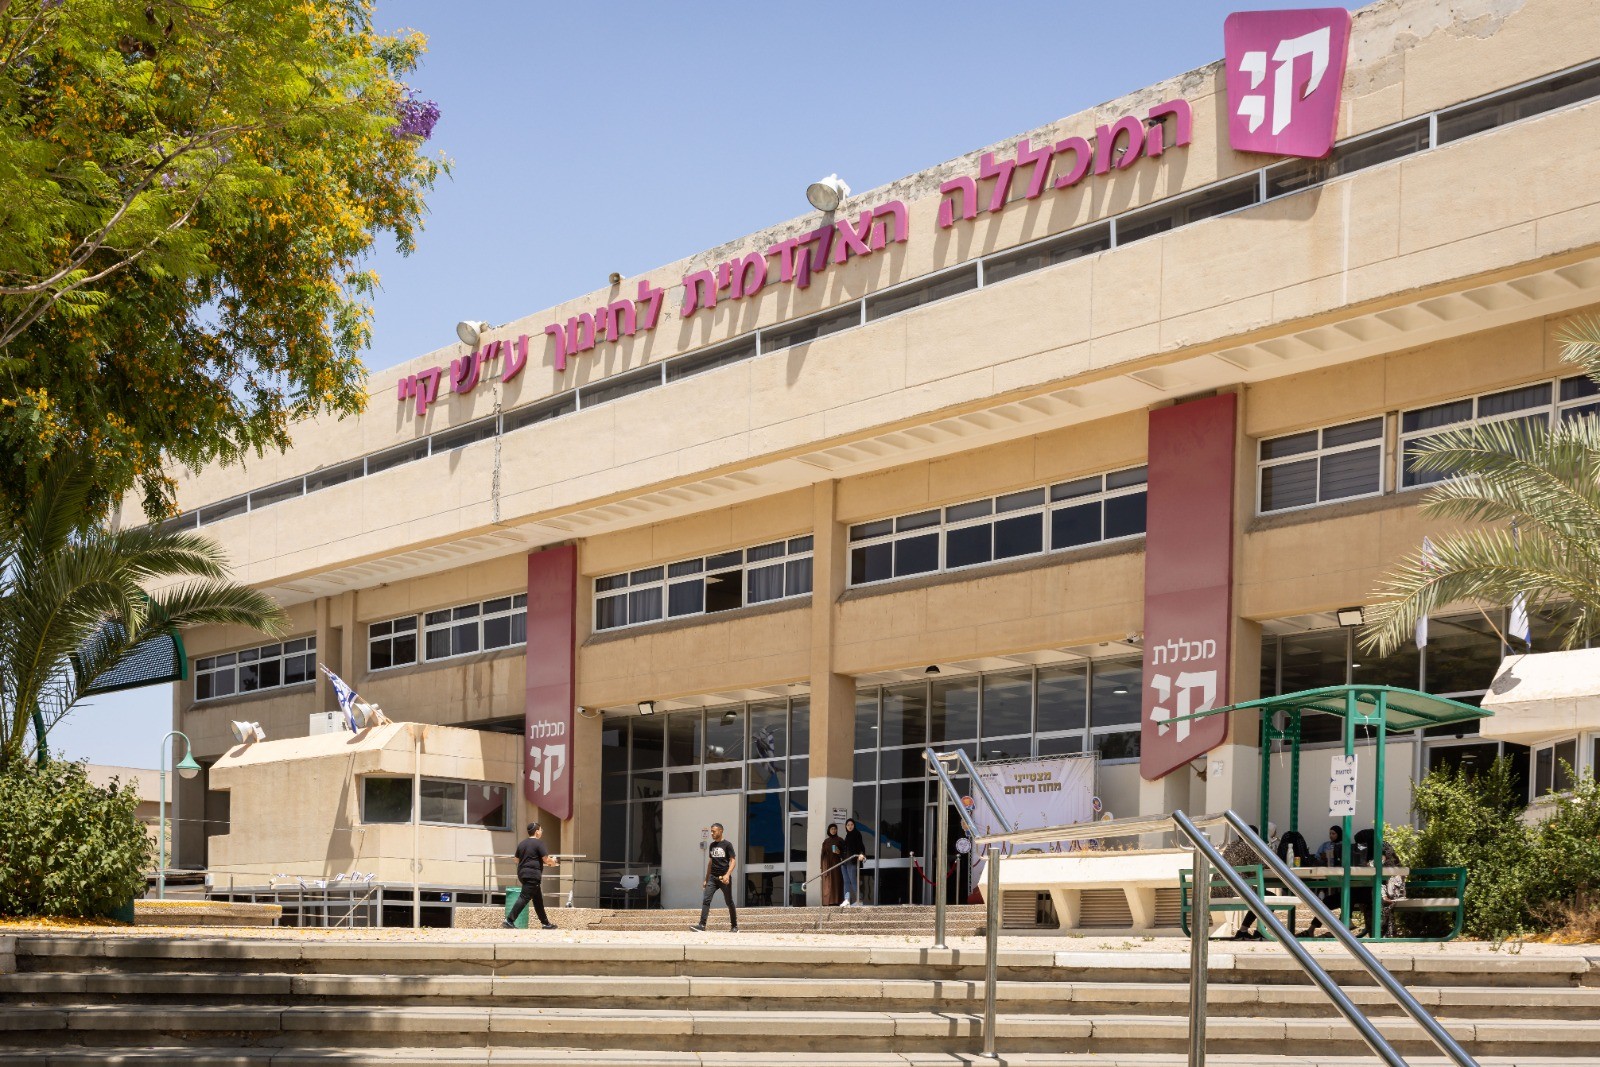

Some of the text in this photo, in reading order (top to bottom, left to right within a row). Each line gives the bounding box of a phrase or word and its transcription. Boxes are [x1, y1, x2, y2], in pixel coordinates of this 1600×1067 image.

[939, 98, 1193, 229] המכללה
[681, 199, 910, 318] האקדמית
[544, 279, 665, 372] לחינוך
[1151, 637, 1217, 666] מכללת
[529, 719, 565, 739] מכללת
[1004, 782, 1062, 795] מחוז הדרום
[1013, 771, 1052, 783] מצטייני
